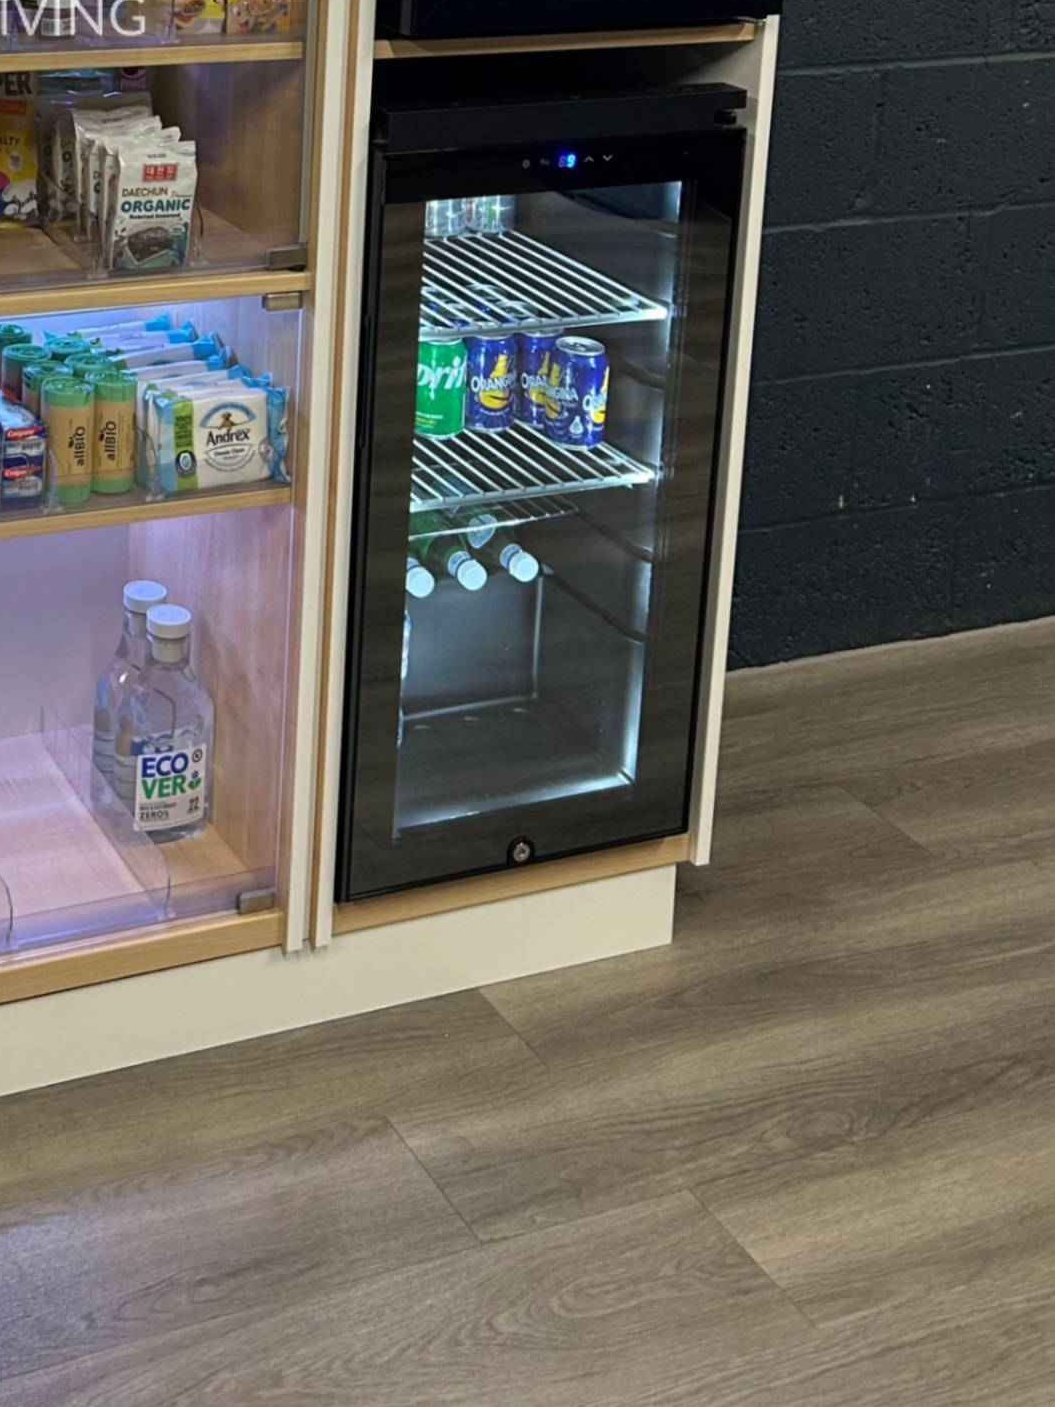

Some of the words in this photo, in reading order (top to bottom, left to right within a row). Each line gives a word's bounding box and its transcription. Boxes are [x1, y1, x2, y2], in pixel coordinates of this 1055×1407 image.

[122, 187, 168, 198] DAECHUN
[120, 198, 191, 214] ORGANIC
[206, 429, 251, 447] Andrex
[141, 752, 189, 779] ECO
[141, 774, 188, 800] VER
